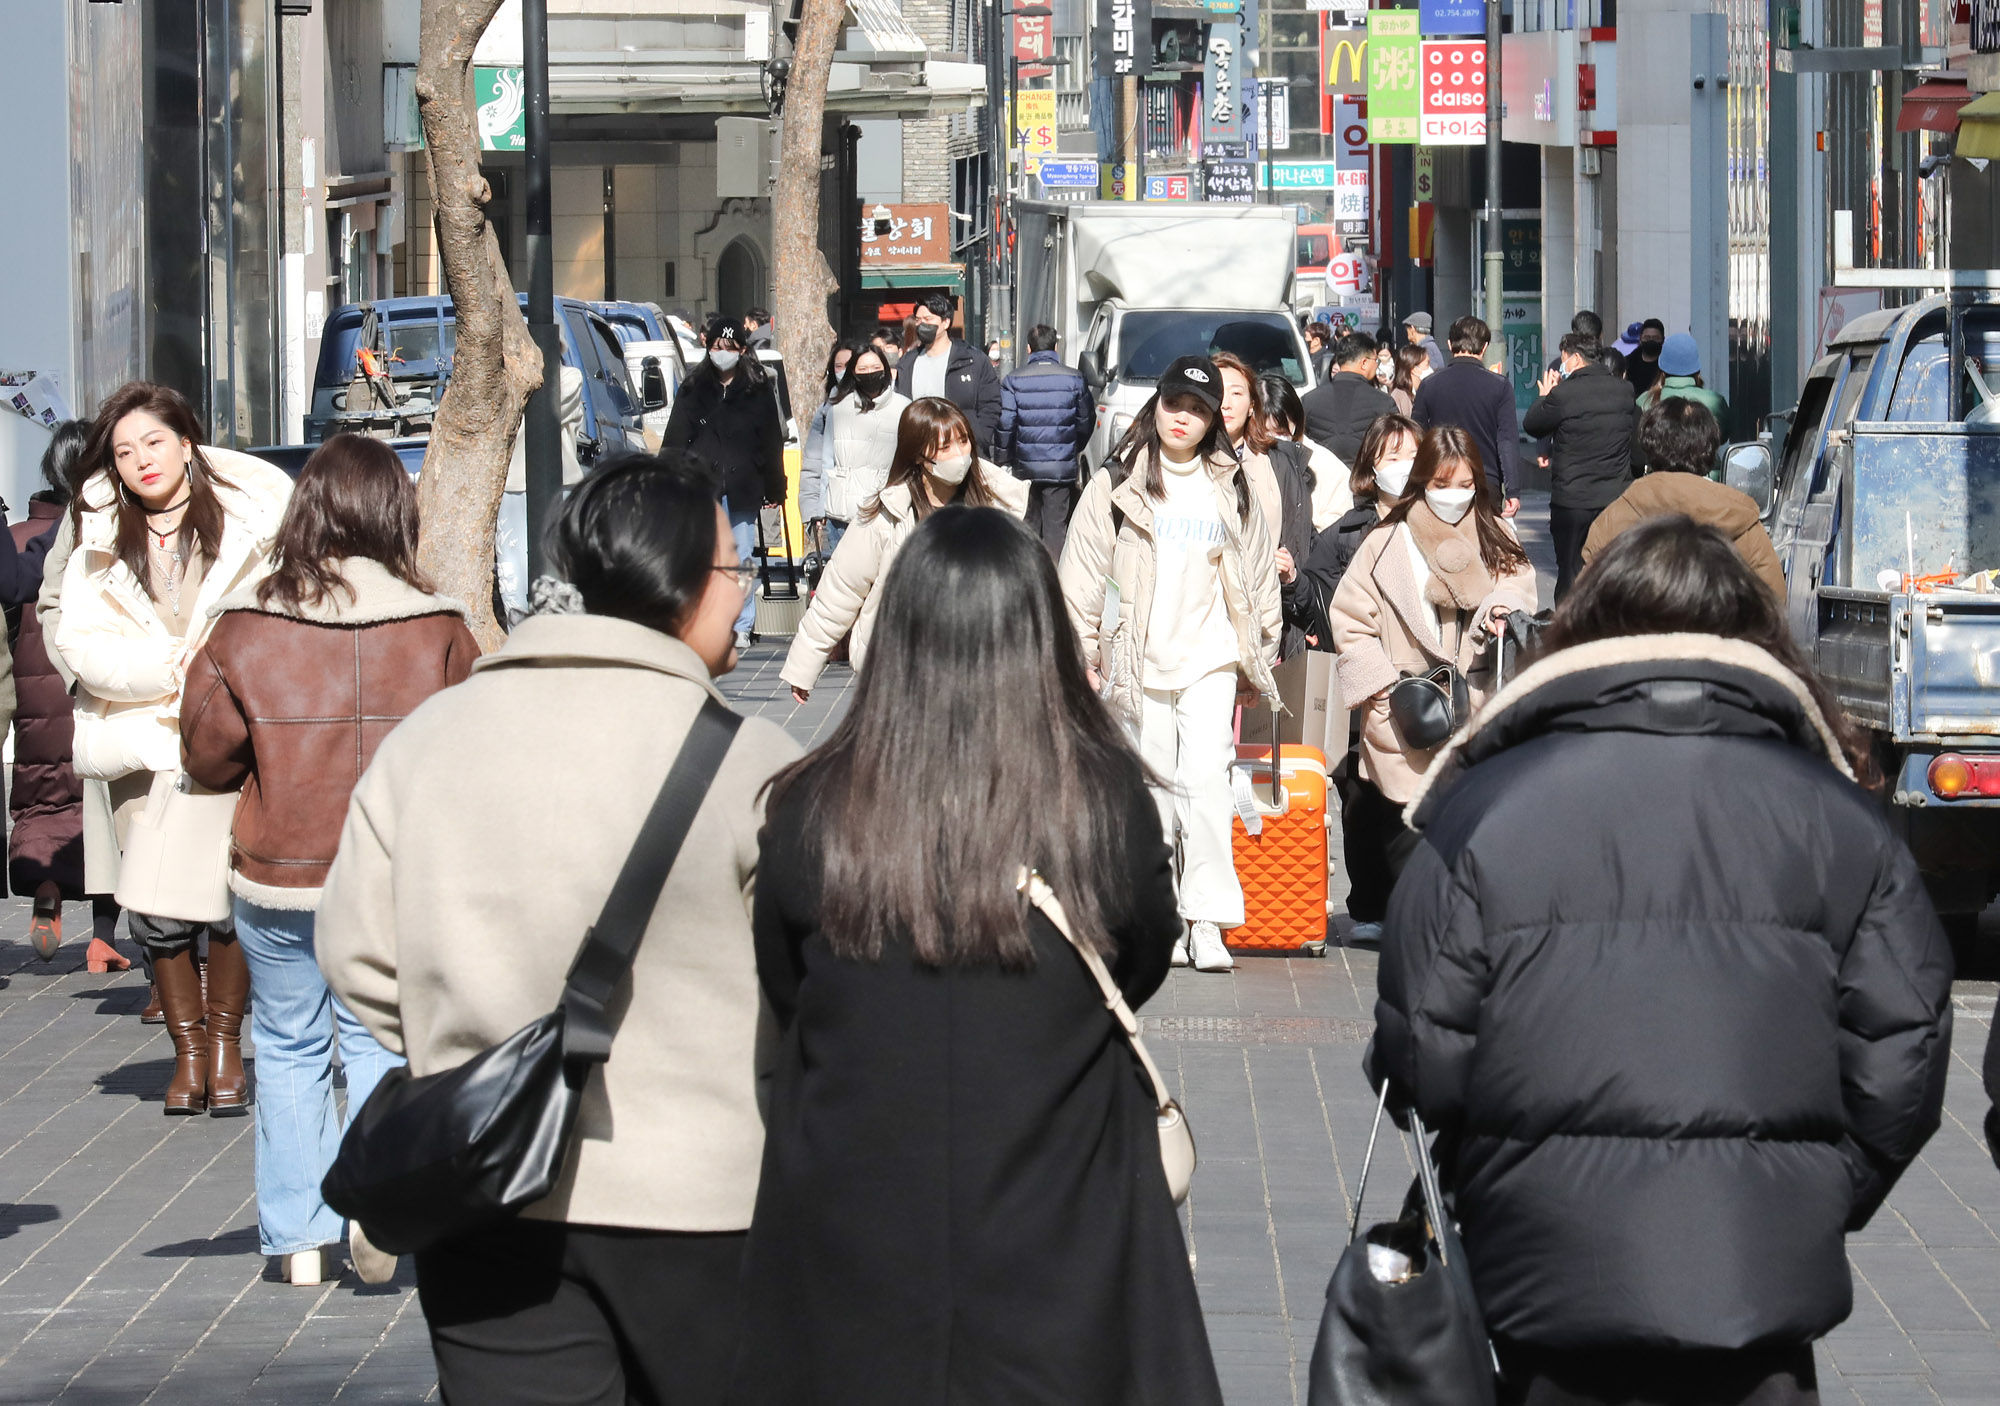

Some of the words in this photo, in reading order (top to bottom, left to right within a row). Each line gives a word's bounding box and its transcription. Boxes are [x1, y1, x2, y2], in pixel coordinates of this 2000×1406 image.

[1111, 0, 1135, 57] 갈비
[1114, 59, 1133, 73] 2F
[1430, 88, 1485, 106] daiso
[1426, 120, 1487, 136] 다이소
[1331, 259, 1363, 291] 약
